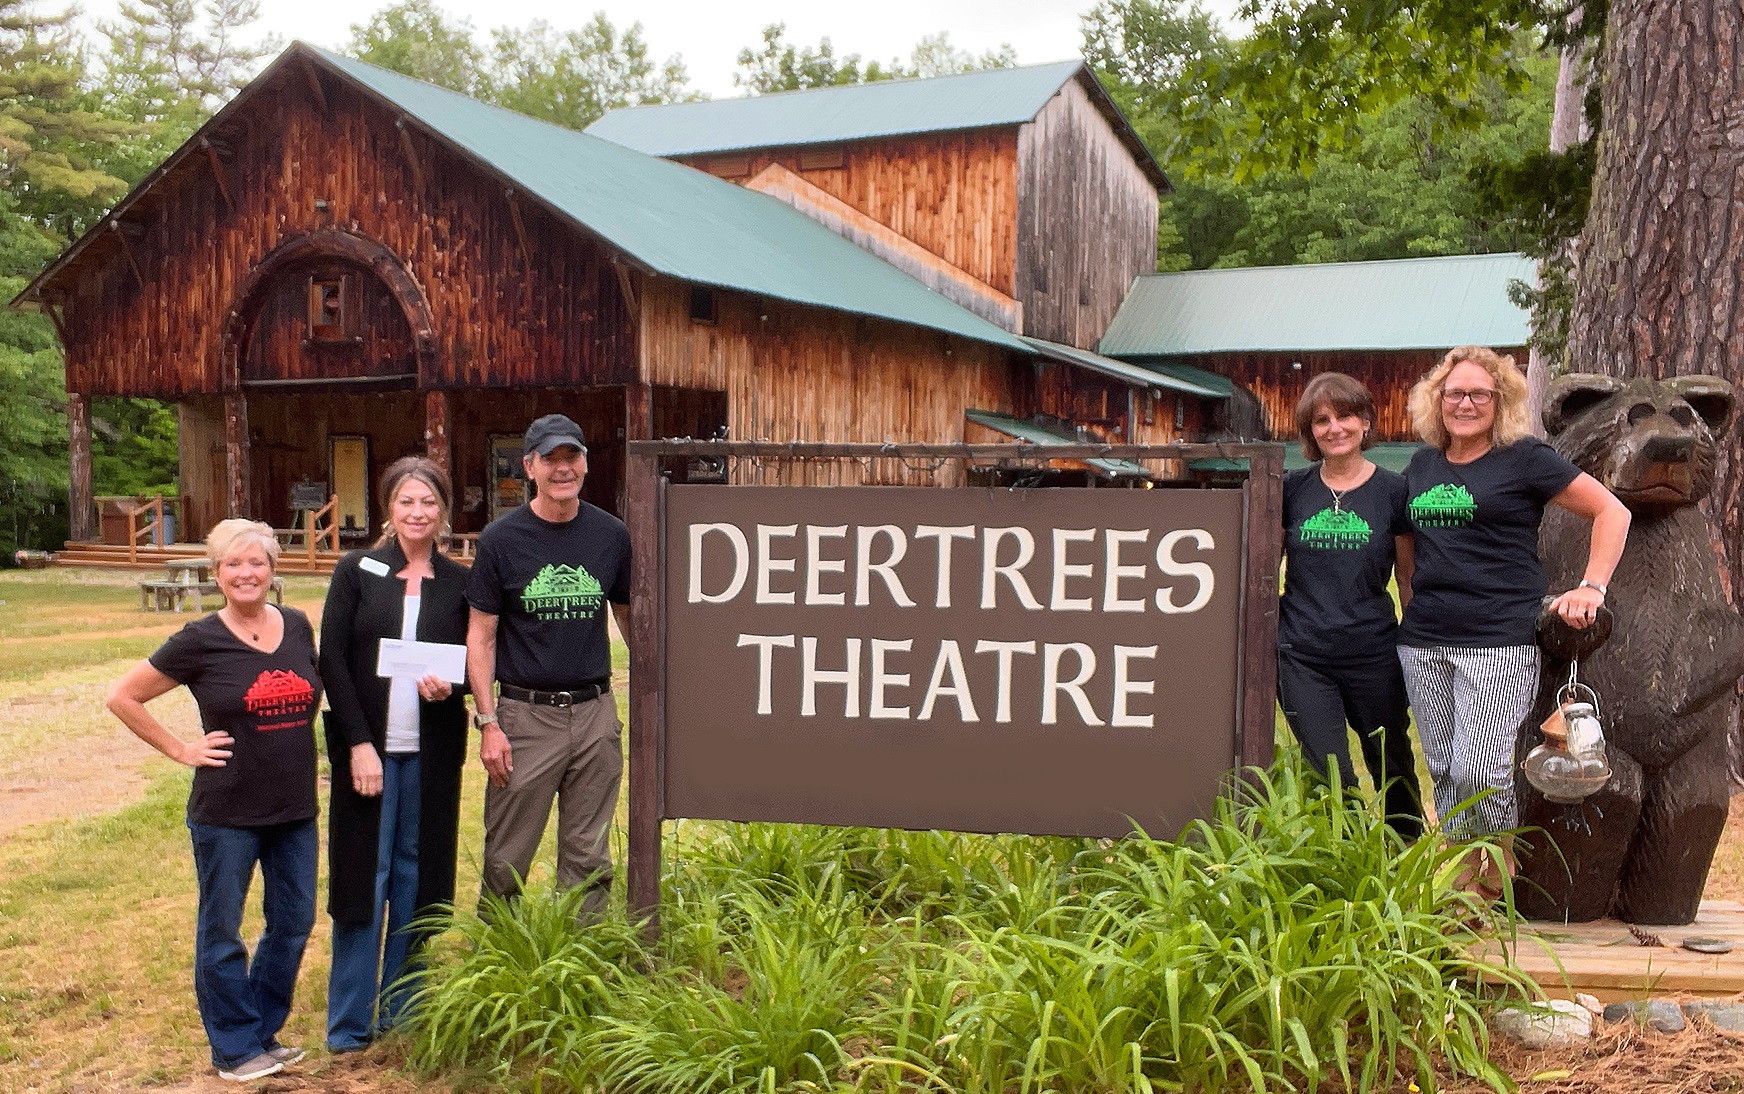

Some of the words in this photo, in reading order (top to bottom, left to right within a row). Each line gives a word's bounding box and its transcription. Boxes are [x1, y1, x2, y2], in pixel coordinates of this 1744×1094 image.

[688, 523, 1215, 614] DEERTREES
[524, 596, 601, 613] DEERTREES
[537, 611, 594, 620] THEATRE
[736, 633, 1158, 727] THEATRE
